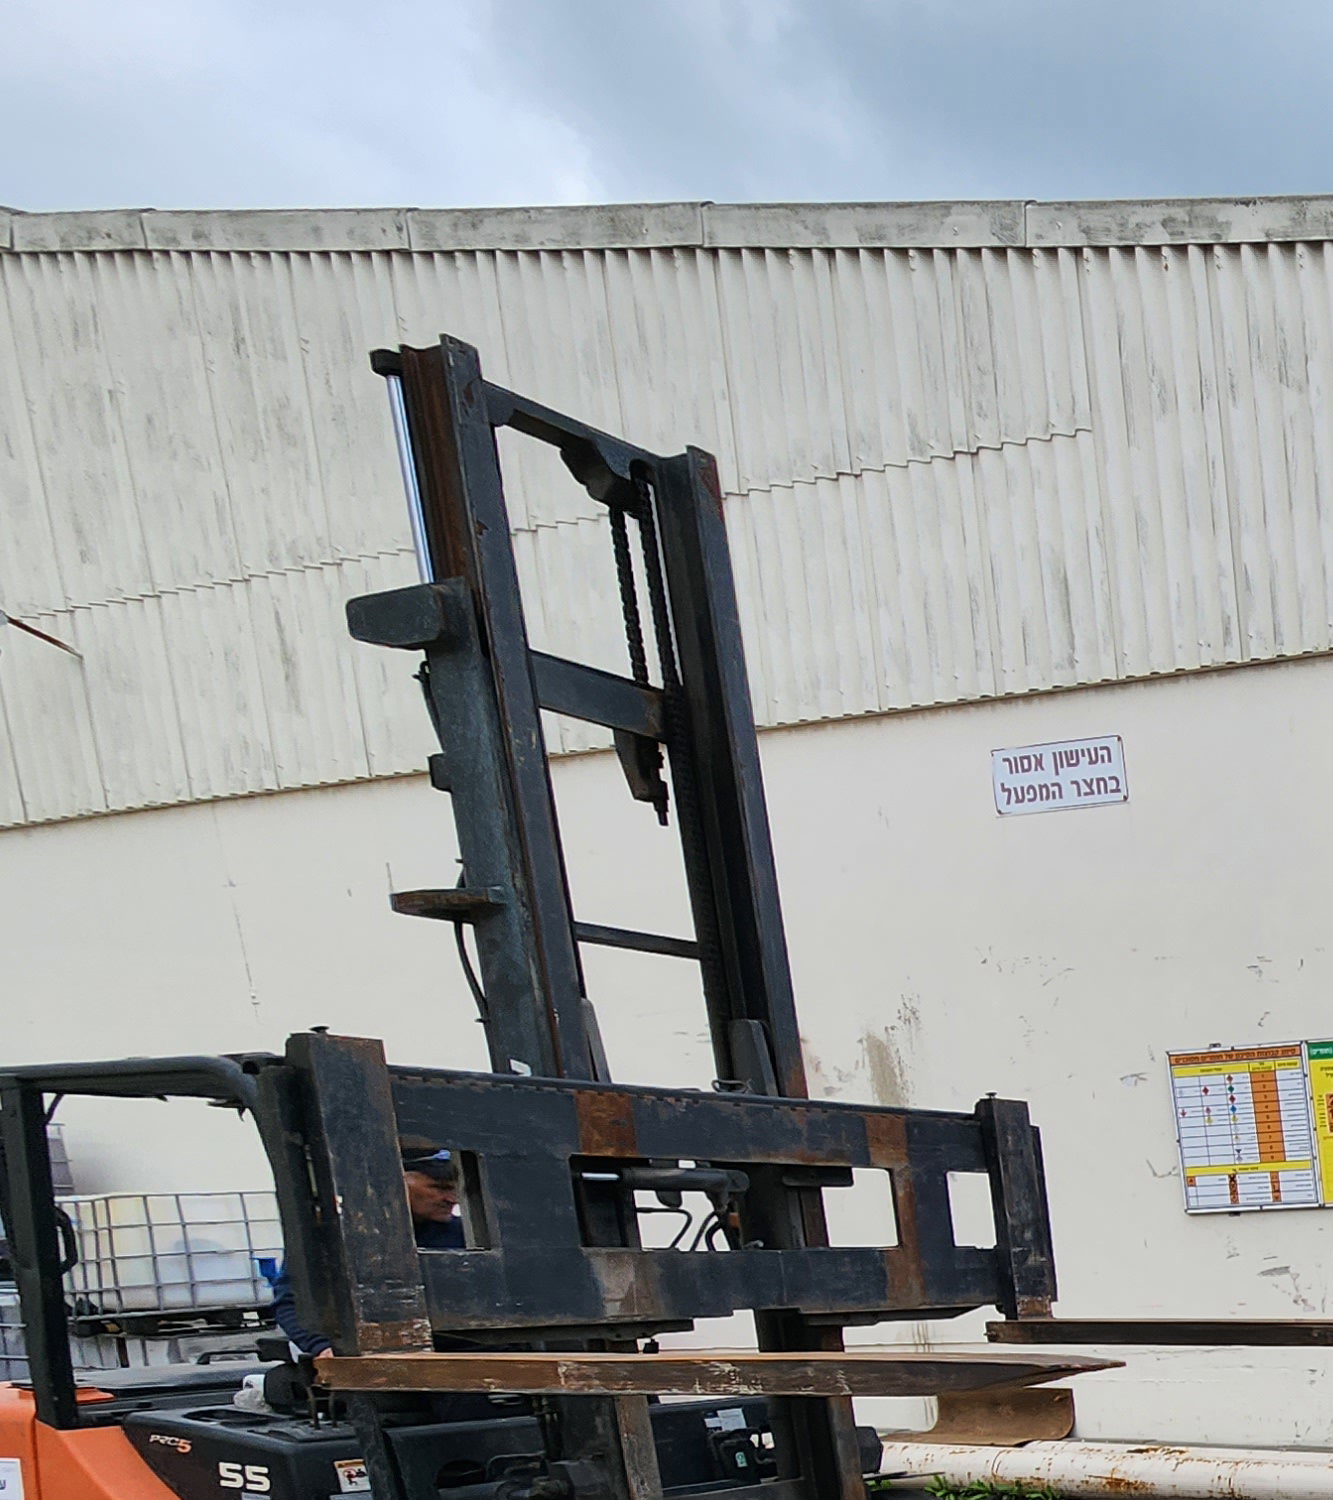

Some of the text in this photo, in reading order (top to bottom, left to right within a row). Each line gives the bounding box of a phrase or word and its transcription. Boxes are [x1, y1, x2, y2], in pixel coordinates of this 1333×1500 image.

[1002, 745, 1112, 776] העישון אסור
[1000, 775, 1121, 805] בחצר המפעל
[218, 1461, 271, 1492] 55
